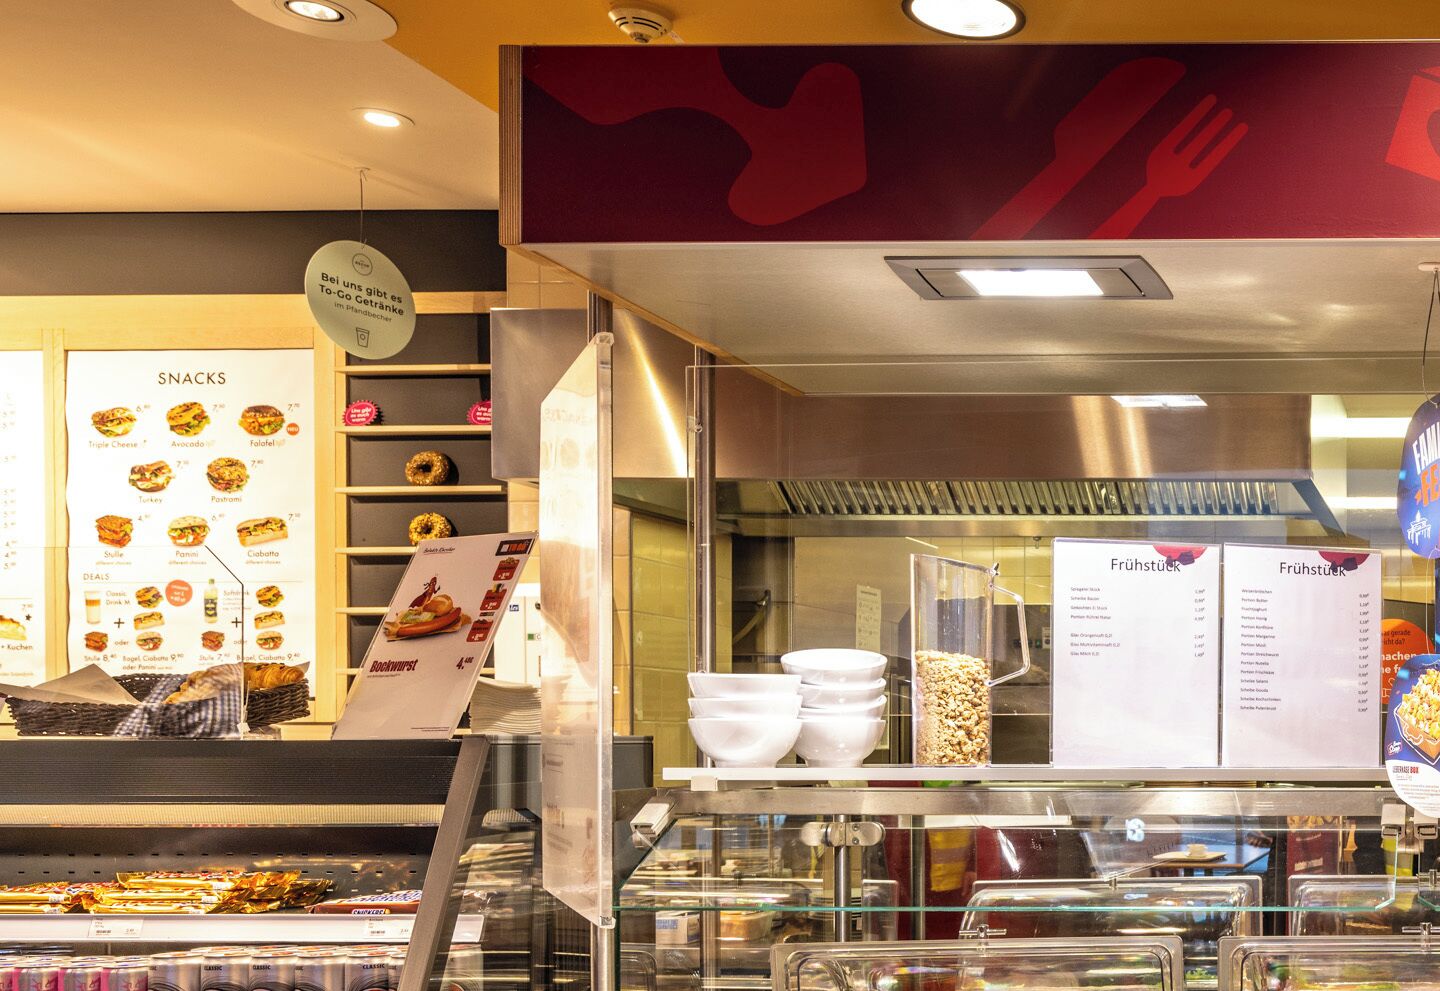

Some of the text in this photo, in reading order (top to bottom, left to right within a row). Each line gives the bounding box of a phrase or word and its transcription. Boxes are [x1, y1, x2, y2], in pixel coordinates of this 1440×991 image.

[321, 272, 403, 303] Bei uns gibt es
[318, 283, 404, 315] To-Go Getränke
[334, 302, 392, 322] im Pfandbecher
[158, 372, 227, 385] SNACKS
[88, 440, 138, 450] Triple Cheese
[171, 440, 205, 448] Avocado
[249, 439, 275, 448] Falafel
[138, 496, 162, 504] Turkey
[210, 495, 242, 503] Pastrami
[104, 550, 124, 558] Stulle
[175, 550, 199, 558] Panini
[247, 550, 280, 558] Ciabatta
[1111, 558, 1181, 573] Frühstück
[1279, 561, 1346, 578] Frühstück
[83, 573, 110, 581] DEALS
[1390, 630, 1411, 638] gerade
[369, 659, 419, 673] Bockwurst
[1410, 766, 1419, 774] BOX
